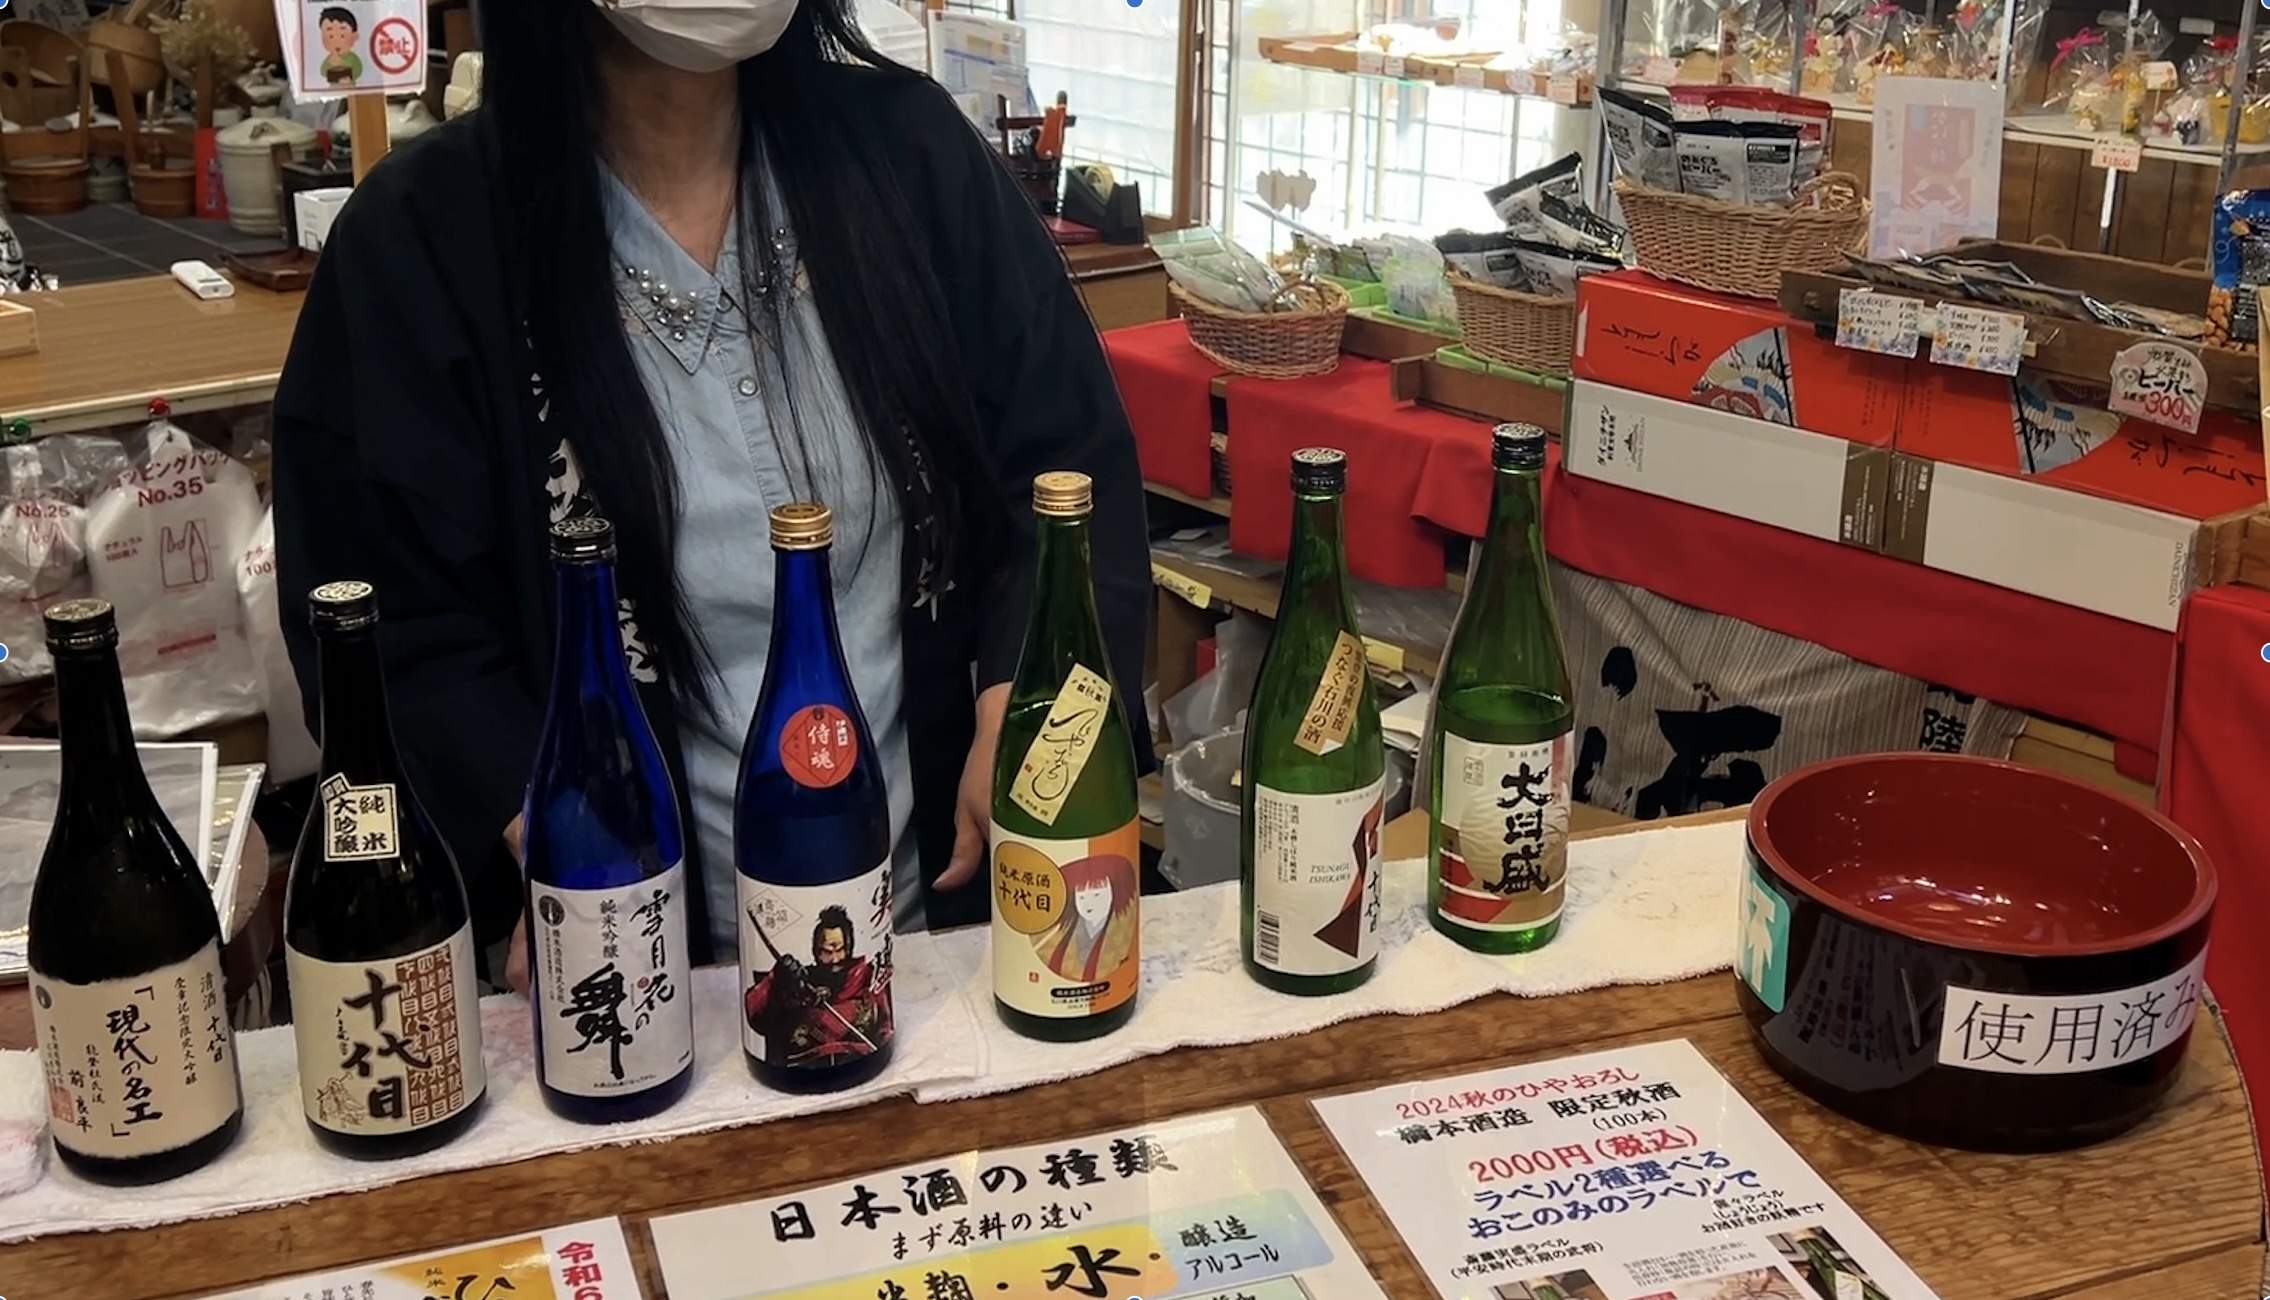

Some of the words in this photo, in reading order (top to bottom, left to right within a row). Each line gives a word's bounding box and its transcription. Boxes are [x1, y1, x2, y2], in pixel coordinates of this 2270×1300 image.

[379, 37, 410, 55] 禁止
[2138, 367, 2194, 395] ビーバー
[2145, 391, 2192, 426] 300円
[16, 505, 70, 518] No.25
[138, 477, 203, 507] No.35
[1304, 643, 1352, 744] つなぐ石川の酒
[808, 723, 835, 769] 侍魂
[334, 797, 360, 853] 大吟醸
[360, 794, 387, 852] 純米
[1482, 761, 1553, 895] 大日盛
[999, 862, 1051, 889] 純米原酒
[999, 881, 1051, 912] 十代目
[601, 899, 620, 958] 純米吟醸
[341, 968, 432, 1119] 十代目
[559, 962, 633, 1079] 舞
[1954, 973, 2197, 1067] 使用済み
[1396, 1066, 1640, 1120] 2024秋のひやおろし
[1547, 1081, 1682, 1118] 限定秋酒
[1591, 1107, 1668, 1132] (100本)
[770, 1134, 1179, 1242] 日本酒の種類
[1467, 1170, 1761, 1239] おこのみのラベルで
[1473, 1149, 1731, 1210] ラベル2種選べる
[891, 1202, 1093, 1260] まず原料の違い
[1178, 1214, 1257, 1248] 醸造
[1184, 1243, 1280, 1281] アルコール
